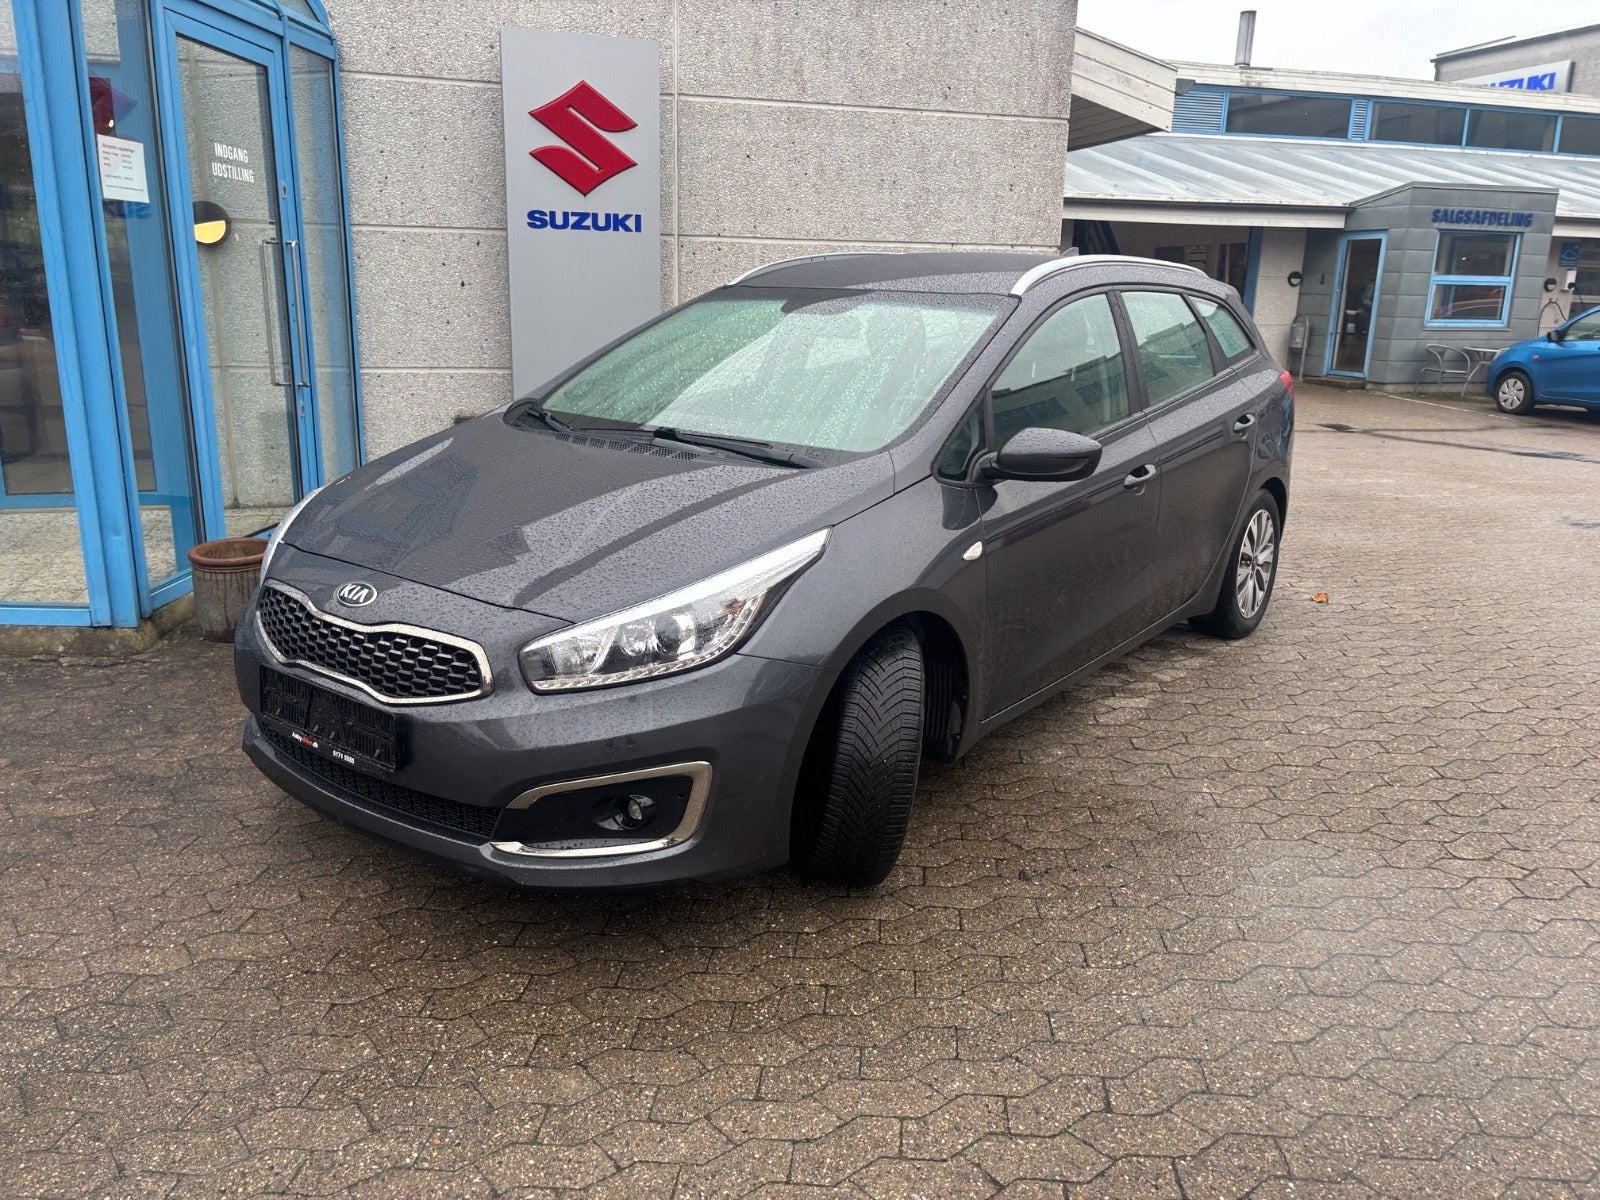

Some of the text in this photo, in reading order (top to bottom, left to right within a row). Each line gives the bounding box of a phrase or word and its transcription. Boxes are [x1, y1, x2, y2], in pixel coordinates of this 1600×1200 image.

[214, 142, 249, 163] INDGANG
[211, 161, 255, 183] UDSTILLING
[526, 209, 642, 233] SUZUKI
[1431, 208, 1535, 228] SALGSAFDELING
[340, 583, 369, 603] KIA
